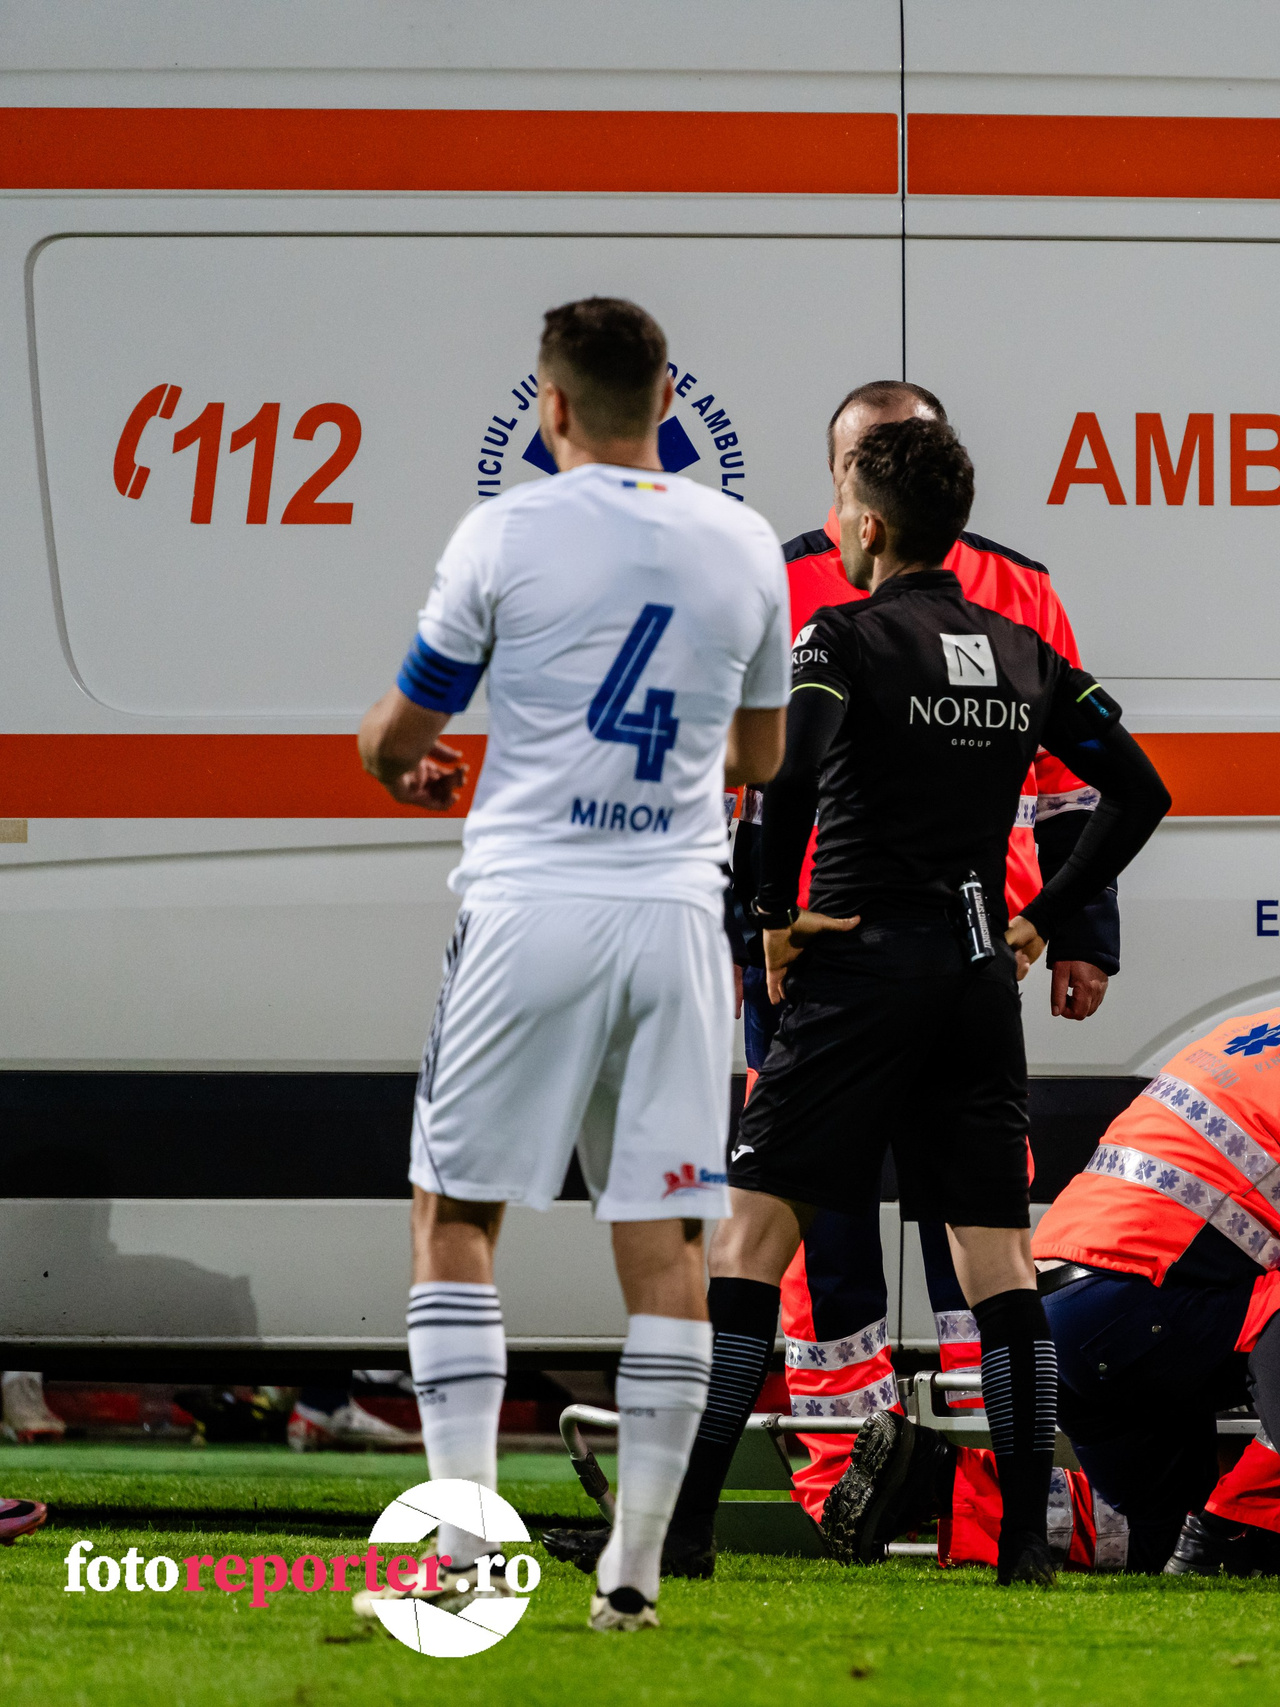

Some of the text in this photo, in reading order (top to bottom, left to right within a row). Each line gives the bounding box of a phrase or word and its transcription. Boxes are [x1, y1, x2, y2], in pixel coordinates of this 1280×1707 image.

[172, 402, 362, 525] 112
[587, 604, 680, 783] 4
[908, 695, 1031, 732] NORDIS
[951, 737, 993, 748] GROUP
[569, 797, 674, 834] MIRON
